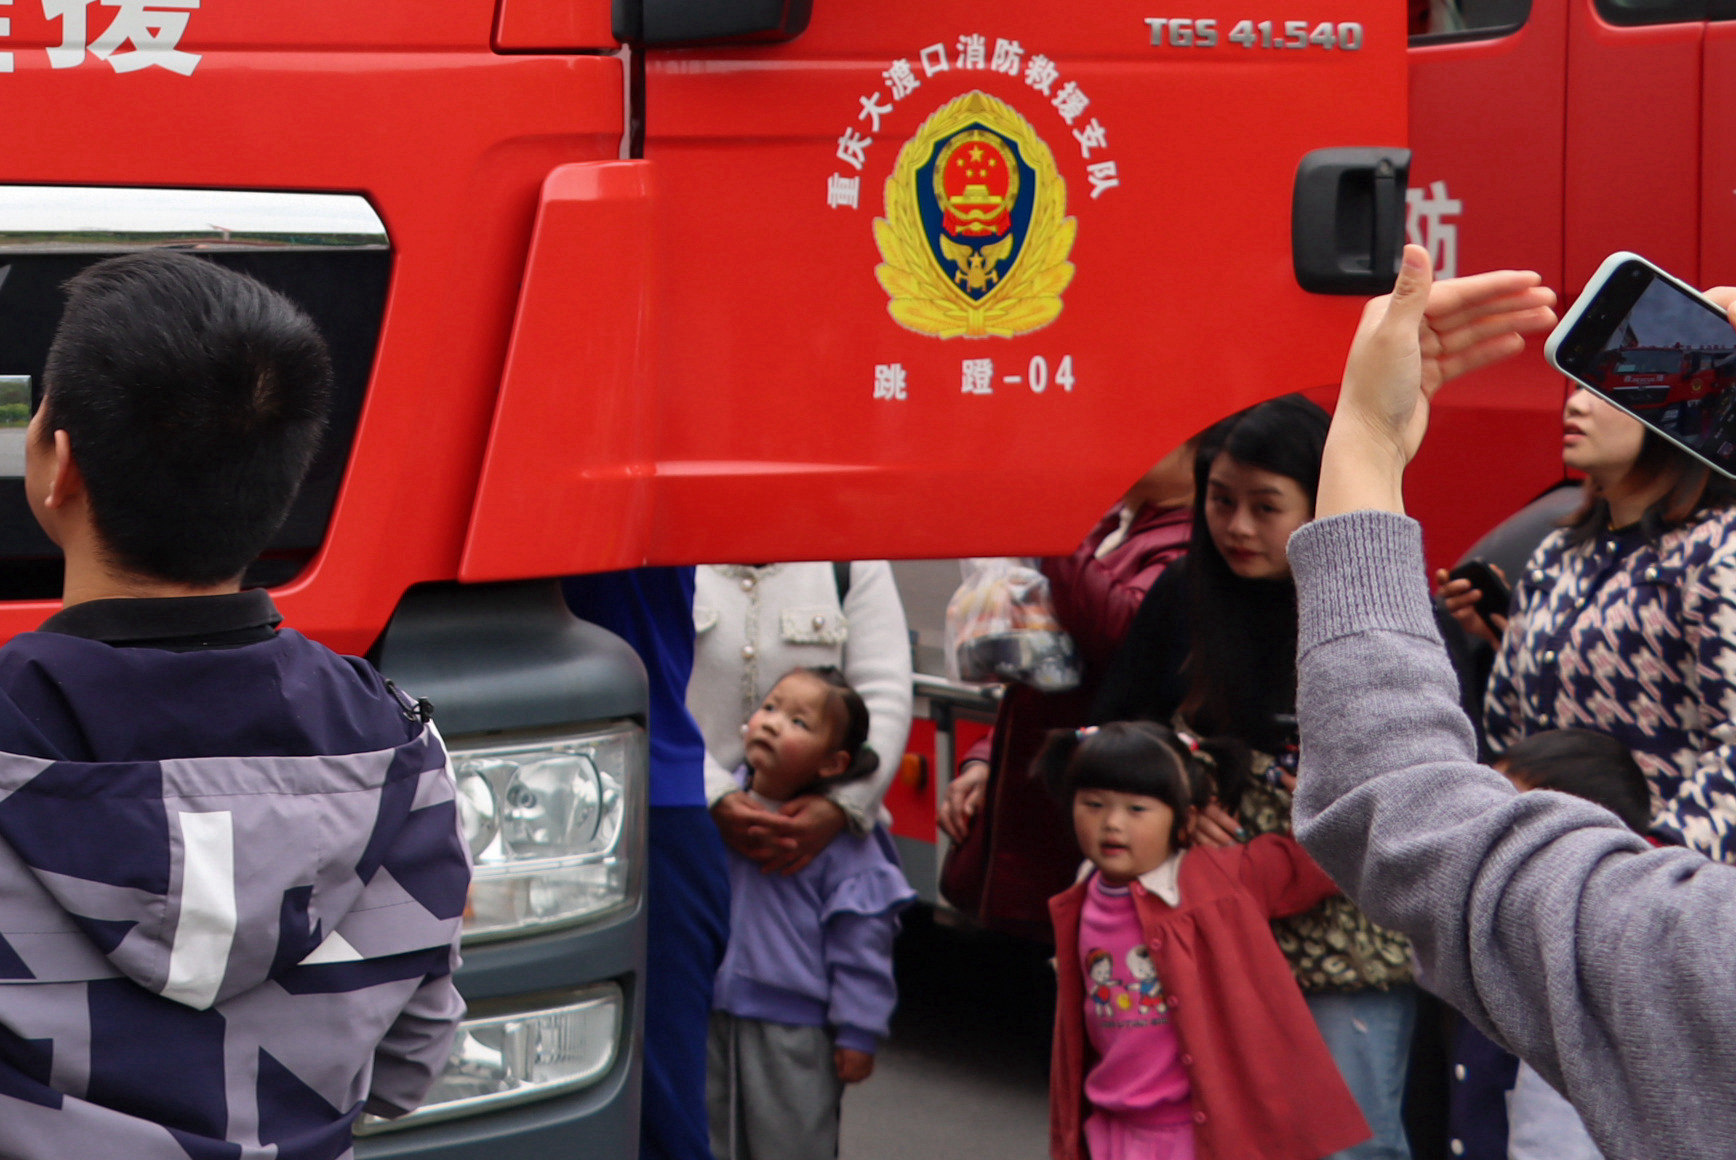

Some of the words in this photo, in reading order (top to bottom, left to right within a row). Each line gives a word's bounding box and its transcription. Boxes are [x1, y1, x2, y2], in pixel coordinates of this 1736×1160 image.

[1144, 17, 1218, 47] TGS
[1228, 19, 1364, 50] 41.540
[826, 33, 1120, 210] 重庆大渡口消防救援支队
